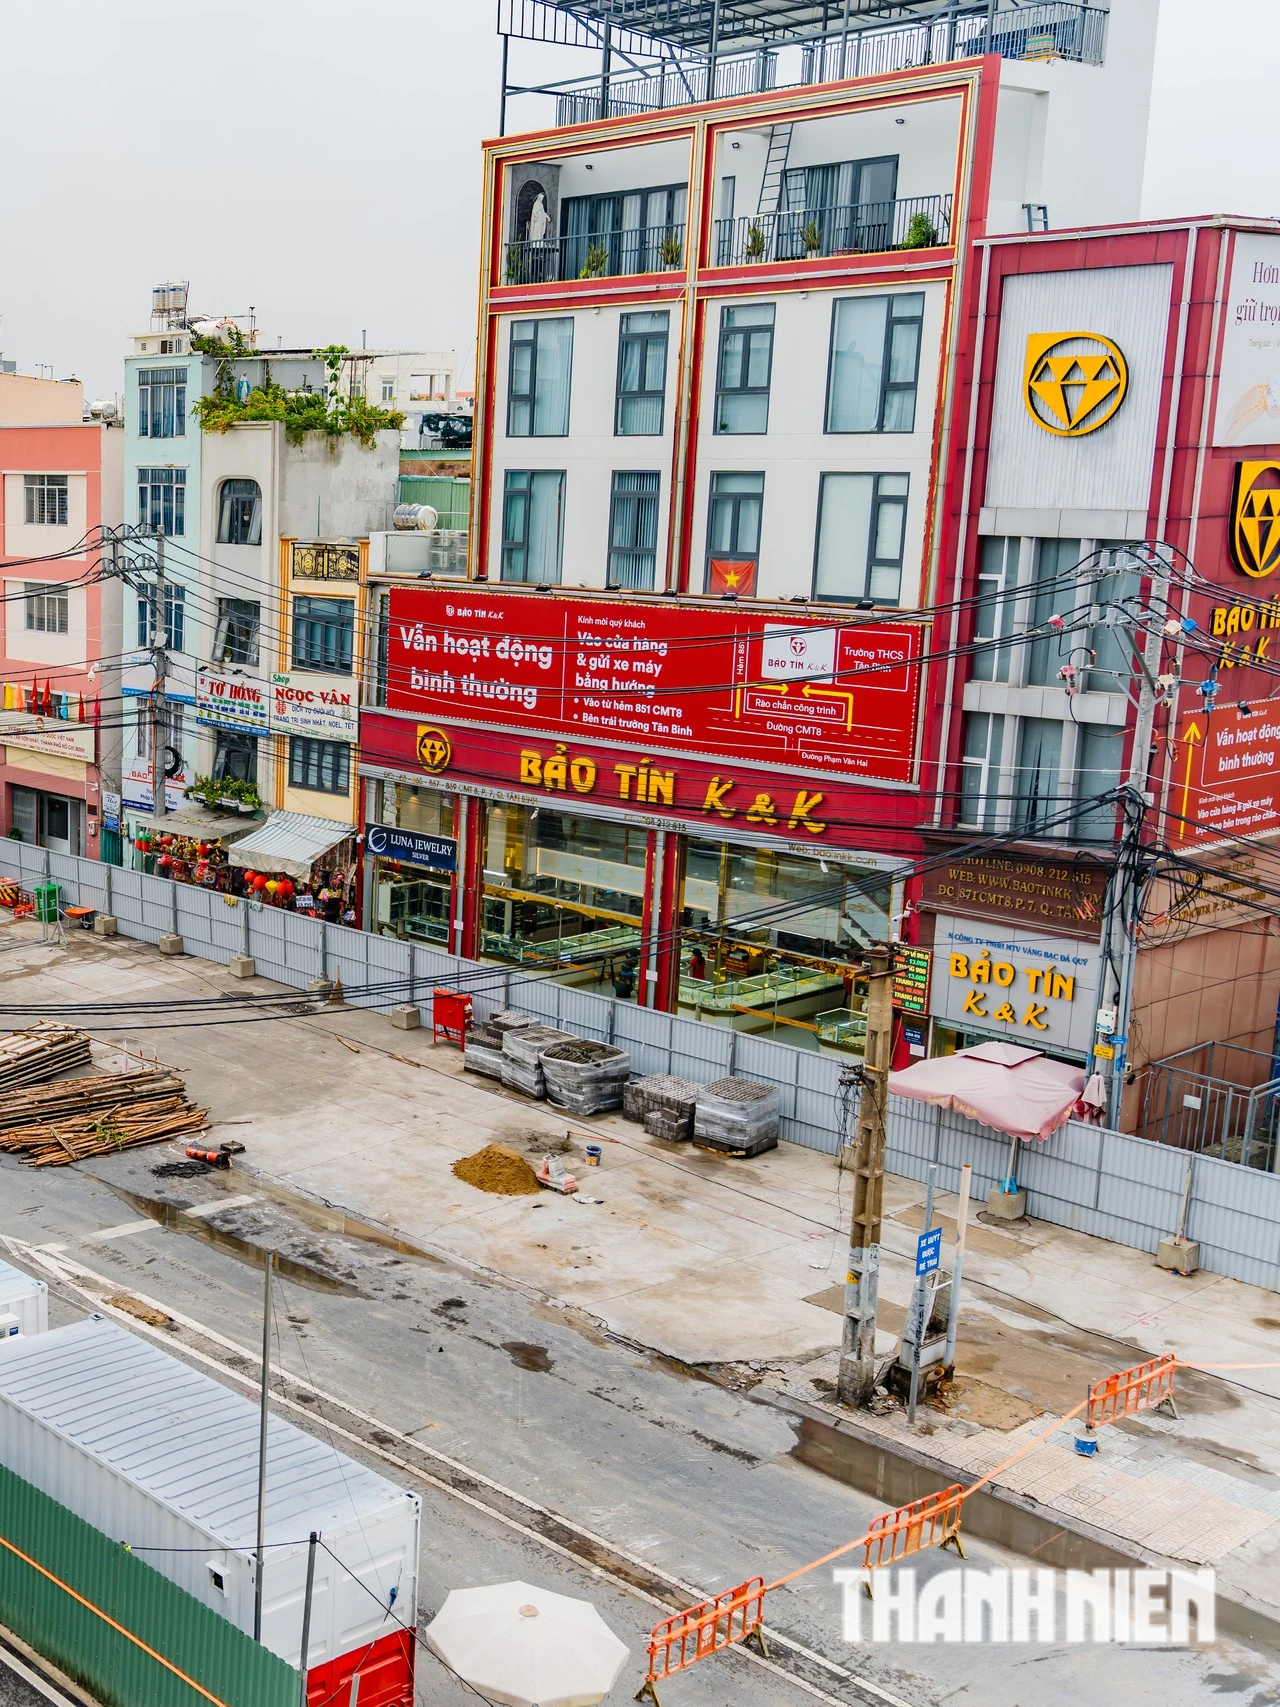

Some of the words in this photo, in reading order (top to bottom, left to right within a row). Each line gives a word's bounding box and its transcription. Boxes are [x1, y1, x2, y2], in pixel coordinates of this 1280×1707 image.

[1253, 261, 1279, 284] Hơn
[1235, 299, 1258, 326] giữ
[457, 607, 472, 617] BẢO
[474, 608, 487, 618] TÍN
[578, 615, 594, 625] Kính
[595, 618, 608, 626] mời
[609, 620, 622, 629] quý
[624, 620, 646, 629] khách
[400, 623, 437, 652] Vẫn
[443, 631, 490, 663] hoạt
[495, 636, 553, 670] động
[577, 631, 602, 647] Vào
[633, 636, 668, 657] hàng
[844, 647, 875, 660] Trường
[877, 649, 904, 660] THCS
[576, 653, 587, 667] &
[589, 653, 610, 671] gửi
[613, 659, 629, 671] xe
[632, 660, 662, 677] máy
[768, 657, 787, 668] BẢO
[790, 659, 804, 669] TÍN
[272, 674, 290, 685] Shop
[411, 666, 455, 694] bình
[461, 673, 537, 710] thường
[612, 677, 656, 698] hướng
[209, 681, 227, 696] TƠ
[229, 681, 261, 703] HỒNG
[275, 688, 314, 705] NGỌC
[320, 689, 351, 706] VÂN
[583, 697, 600, 708] Vào
[601, 698, 613, 709] từ
[613, 699, 634, 711] hẻm
[635, 704, 651, 714] 851
[652, 705, 683, 718] CMT8
[755, 698, 770, 709] Rào
[772, 699, 792, 711] chắn
[794, 702, 814, 714] công
[816, 704, 837, 716] trình
[273, 715, 289, 723] TRANG
[345, 721, 354, 730] TẾT
[582, 712, 600, 723] Bên
[601, 715, 617, 726] trái
[618, 718, 650, 732] trường
[651, 721, 669, 733] Tân
[671, 723, 693, 736] Bình
[766, 721, 793, 734] Đường
[795, 724, 822, 736] CMT8
[1216, 727, 1235, 747] Vẫn
[1236, 726, 1257, 745] hoạt
[1258, 723, 1280, 742] động
[801, 751, 823, 763] Đường
[824, 754, 842, 765] Phạm
[843, 756, 856, 766] Văn
[856, 757, 869, 767] Hai
[1218, 754, 1239, 772] bình
[1242, 751, 1275, 768] thường
[521, 743, 596, 793] BẢO
[614, 757, 676, 808] TÍN
[702, 776, 737, 819] K
[746, 793, 778, 827] &
[788, 790, 827, 834] K
[1197, 810, 1209, 819] Vào
[1222, 804, 1236, 816] hàng
[1260, 796, 1273, 806] máy
[1222, 817, 1235, 828] bên
[1235, 815, 1251, 828] trong
[1251, 812, 1262, 823] rào
[390, 834, 413, 848] LUNA
[415, 838, 453, 856] JEWELRY
[412, 851, 430, 861] SILVER
[949, 868, 976, 883] WEB:
[1057, 904, 1081, 920] TÂN
[955, 932, 973, 944] CÔNG
[975, 937, 984, 945] TY
[985, 940, 1005, 949] TNHH
[1005, 943, 1021, 953] MTV
[1022, 946, 1042, 957] VÀNG
[1043, 951, 1059, 961] BẠC
[1060, 954, 1071, 963] ĐÁ
[1072, 956, 1089, 966] QUÝ
[949, 950, 1016, 988] BẢO
[1024, 965, 1075, 1002] TÍN
[962, 989, 989, 1017] K
[993, 1002, 1017, 1023] &
[1022, 1002, 1049, 1031] K
